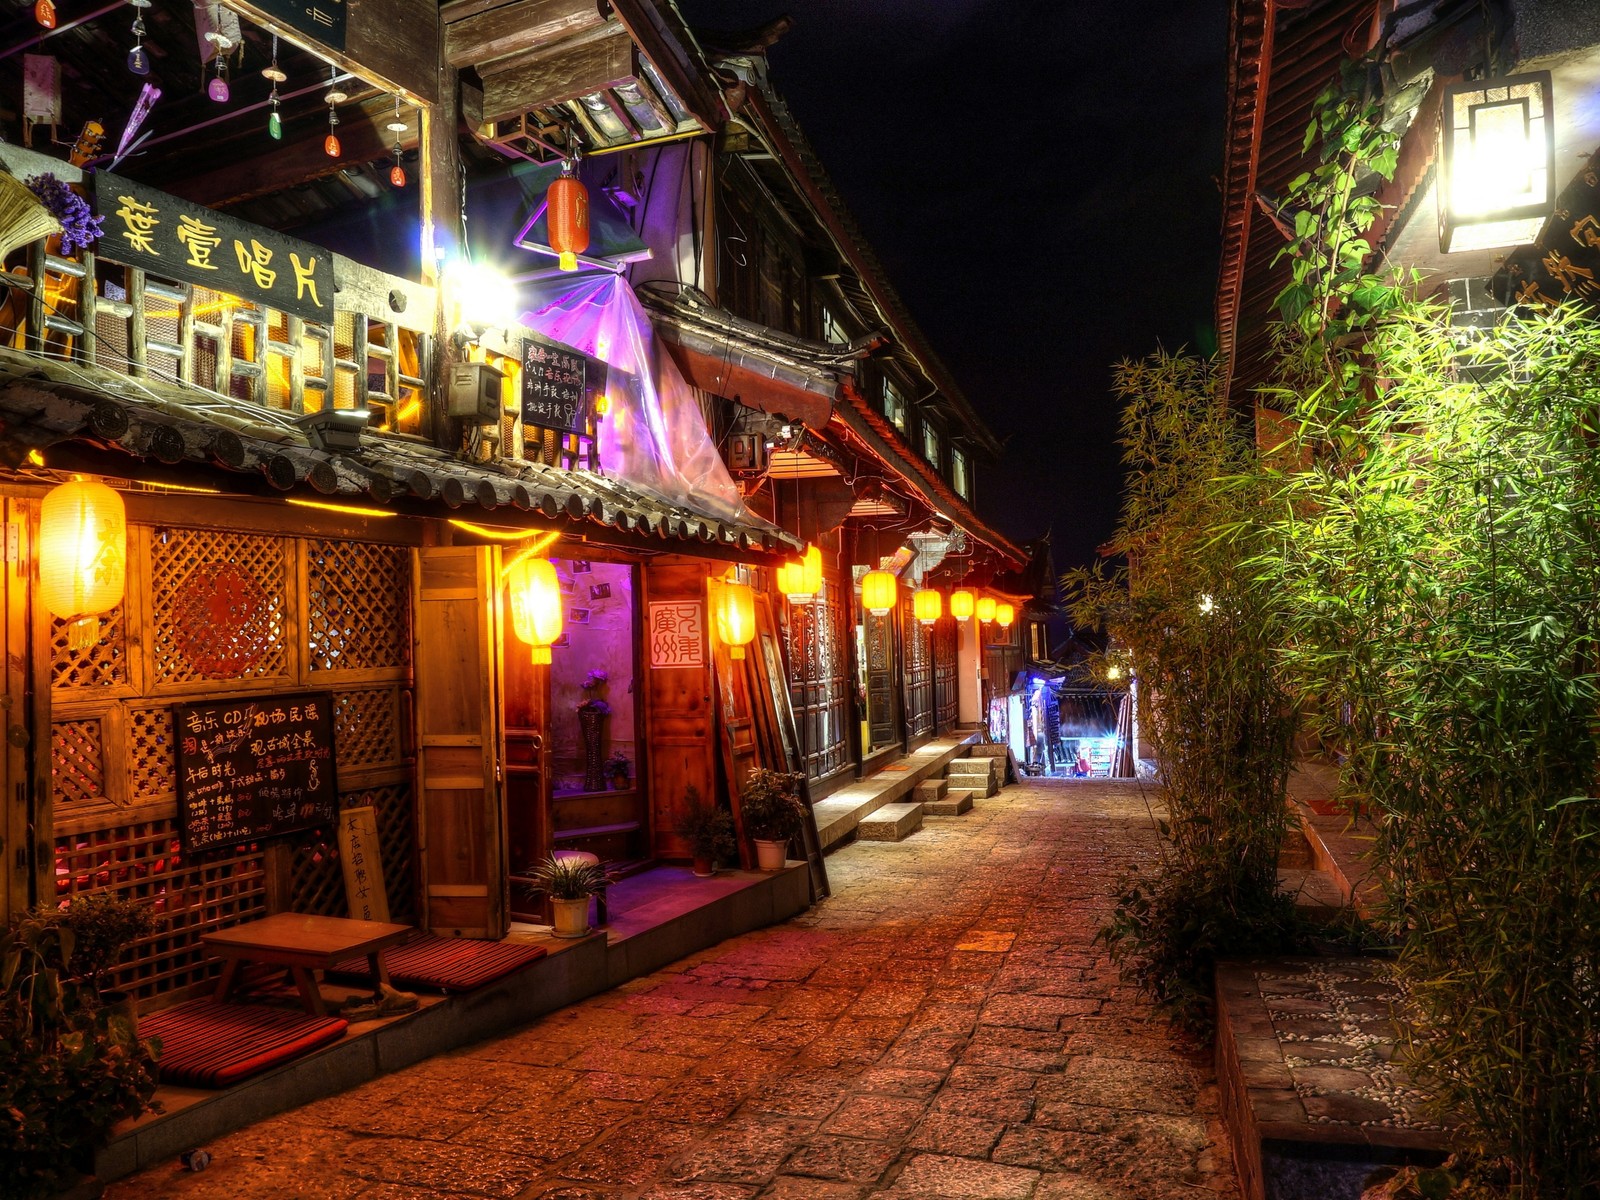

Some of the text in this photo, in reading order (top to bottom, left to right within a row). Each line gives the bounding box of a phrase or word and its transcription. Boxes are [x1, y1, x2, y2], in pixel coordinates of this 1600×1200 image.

[116, 195, 324, 307] 葉壹唱片
[186, 711, 219, 733] 音乐
[224, 710, 242, 724] CD
